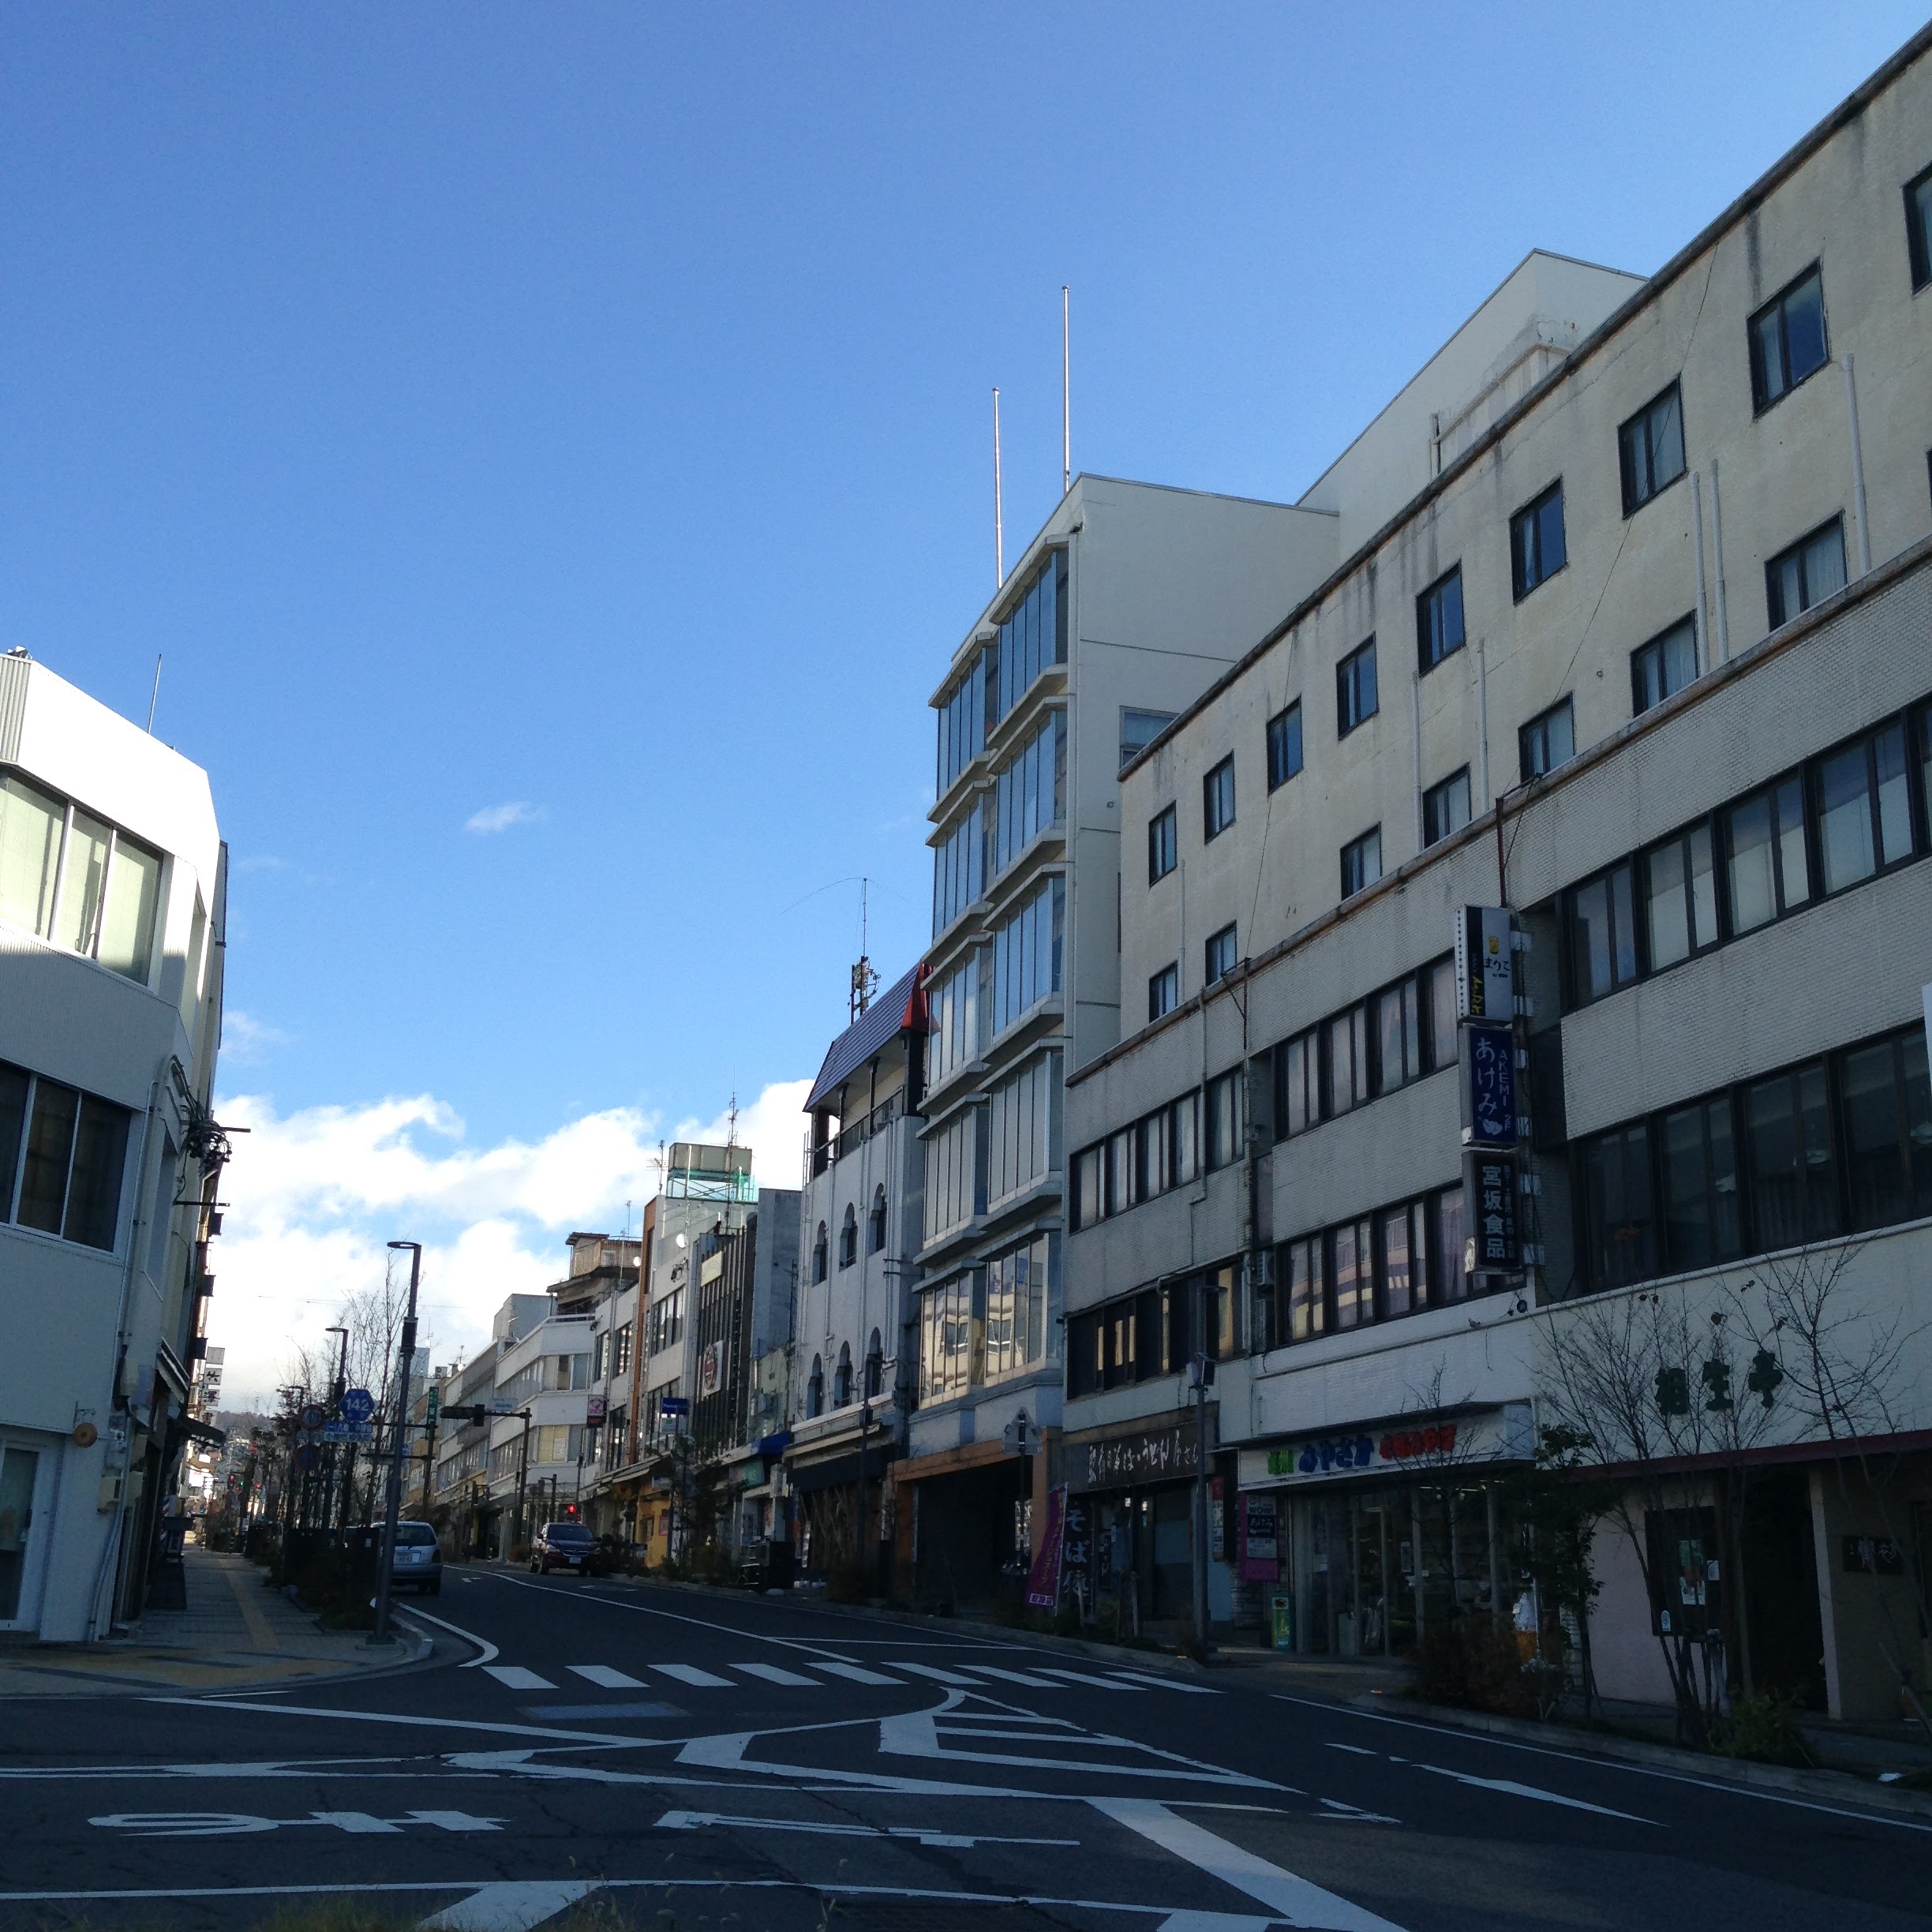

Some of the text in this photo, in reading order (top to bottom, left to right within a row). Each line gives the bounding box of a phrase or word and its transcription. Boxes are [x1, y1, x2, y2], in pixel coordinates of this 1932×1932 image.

[1484, 956, 1510, 972] まりこ
[1475, 1036, 1497, 1116] あけみ
[1498, 1049, 1512, 1132] AKEMI 2F
[1482, 1165, 1506, 1260] 宮坂食品
[345, 1397, 370, 1412] 142
[1249, 1517, 1274, 1528] あけみ
